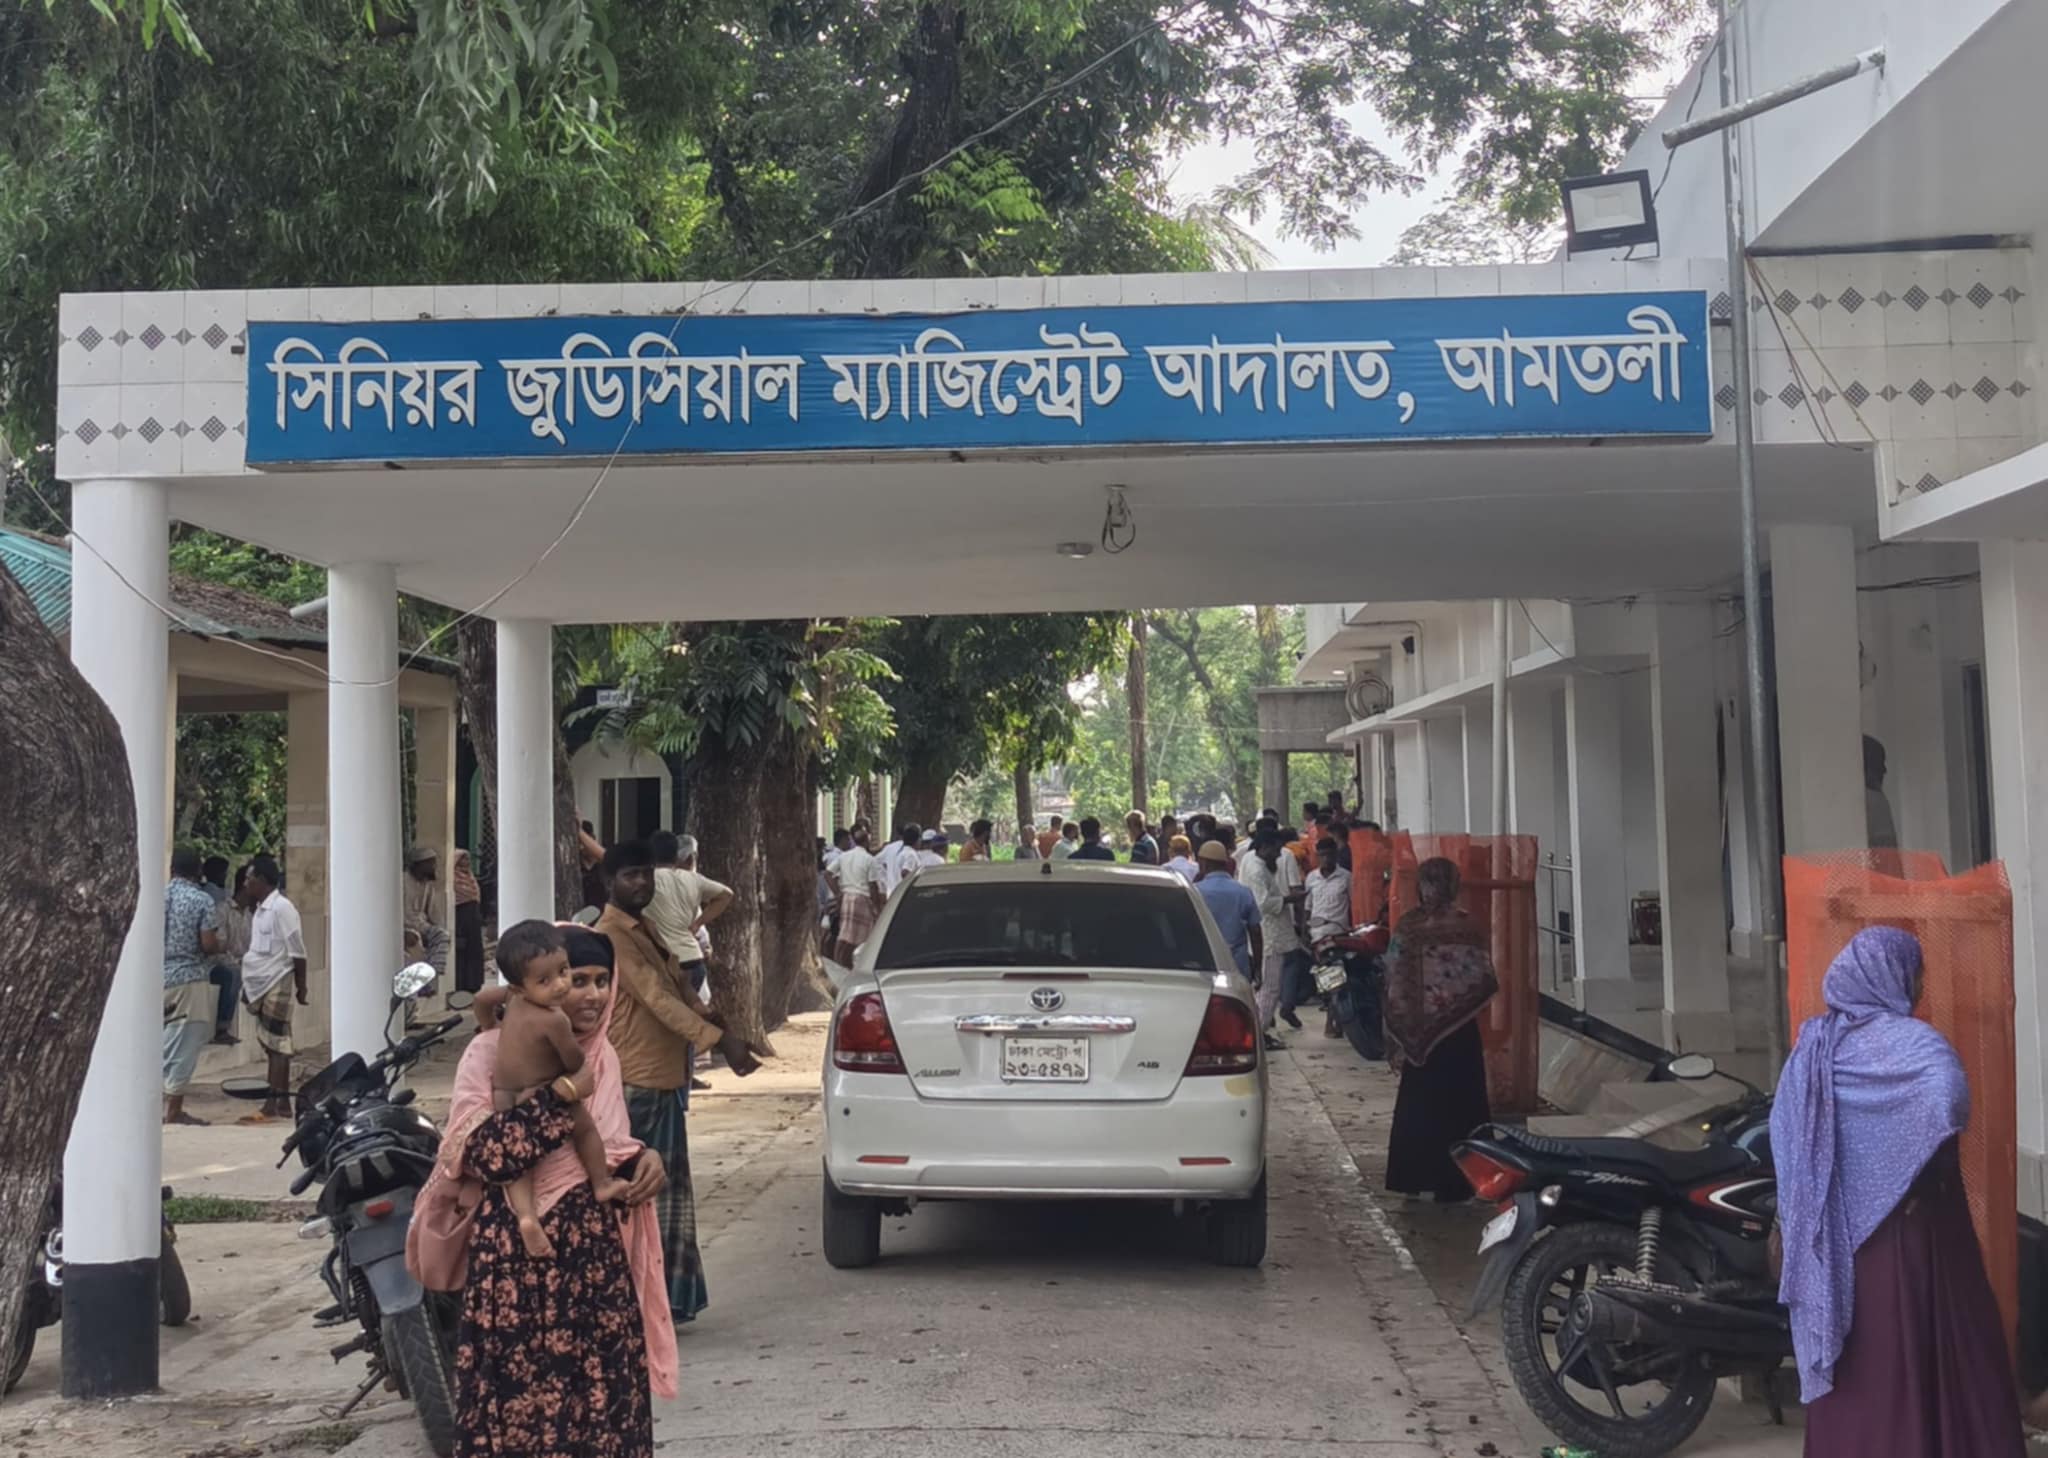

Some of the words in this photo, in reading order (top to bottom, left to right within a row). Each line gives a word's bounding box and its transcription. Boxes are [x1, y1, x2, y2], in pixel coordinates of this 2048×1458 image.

[267, 337, 482, 431] সিনিয়র
[499, 332, 806, 445] জুডিসিয়াল
[822, 322, 1129, 426] ম্যাজিস্ট্রেট
[1145, 333, 1415, 424] আদালত,
[1435, 304, 1688, 407] আমতলী
